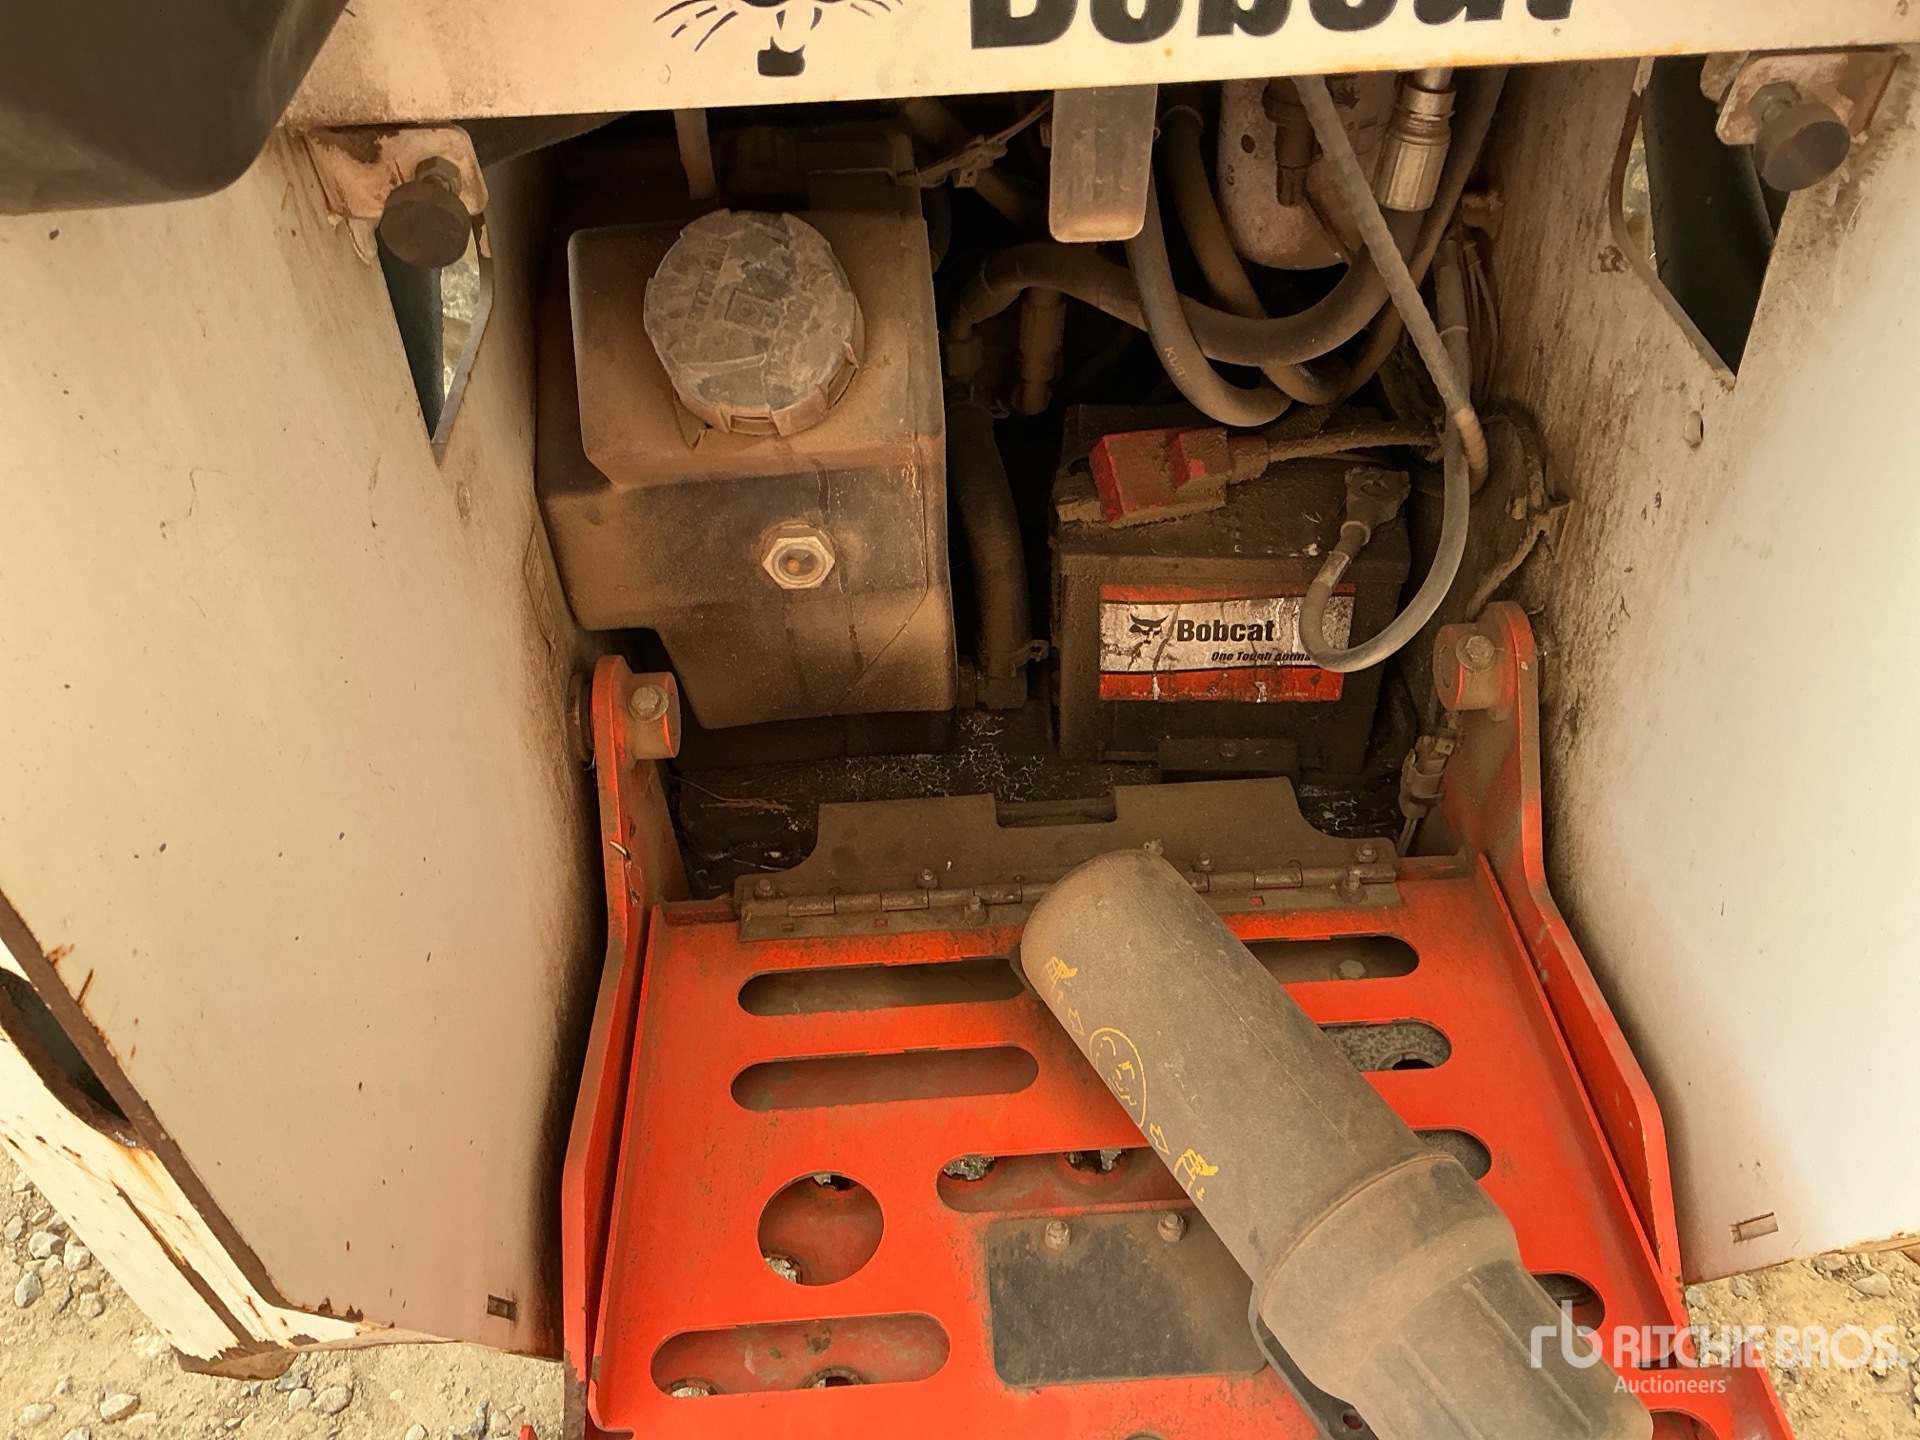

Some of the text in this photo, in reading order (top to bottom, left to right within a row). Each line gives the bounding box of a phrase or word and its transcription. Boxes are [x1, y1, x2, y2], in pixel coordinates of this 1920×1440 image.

[1177, 619, 1275, 642] Bobcat
[1211, 651, 1311, 661] One Tough Anima
